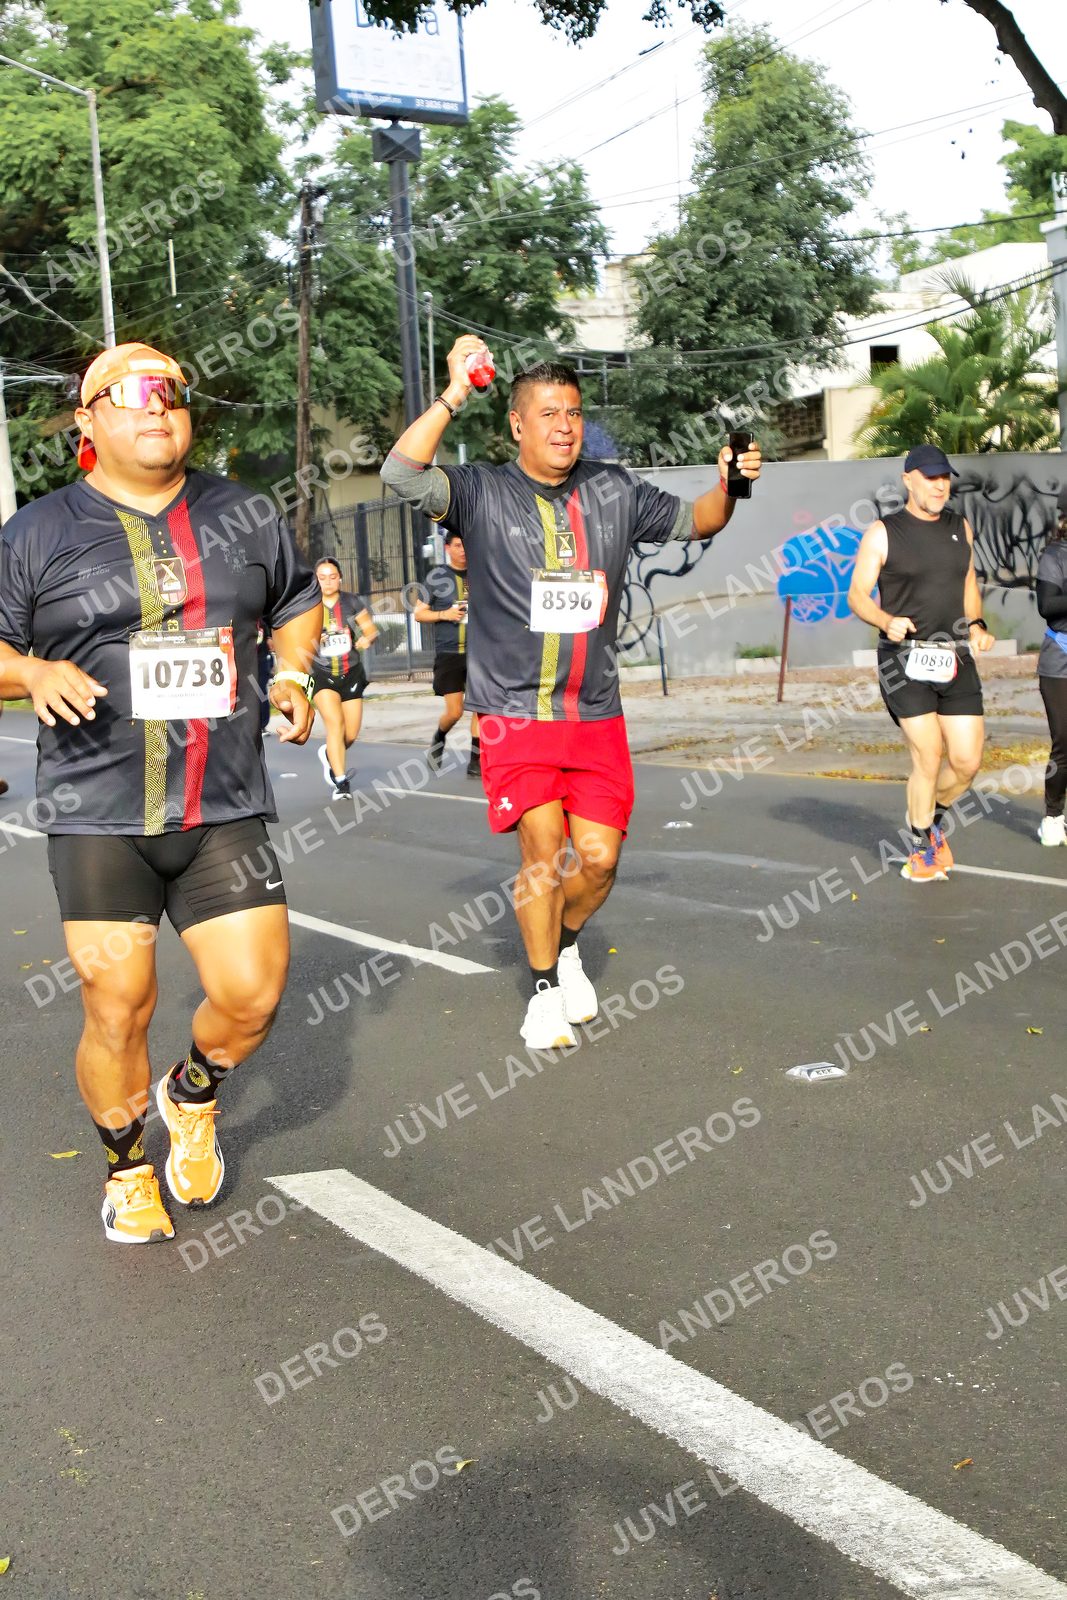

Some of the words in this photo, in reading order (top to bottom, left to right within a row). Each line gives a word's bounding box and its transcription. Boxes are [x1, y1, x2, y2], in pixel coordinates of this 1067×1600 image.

[542, 590, 592, 611] 8596
[914, 652, 953, 668] 10830
[137, 658, 224, 689] 10738
